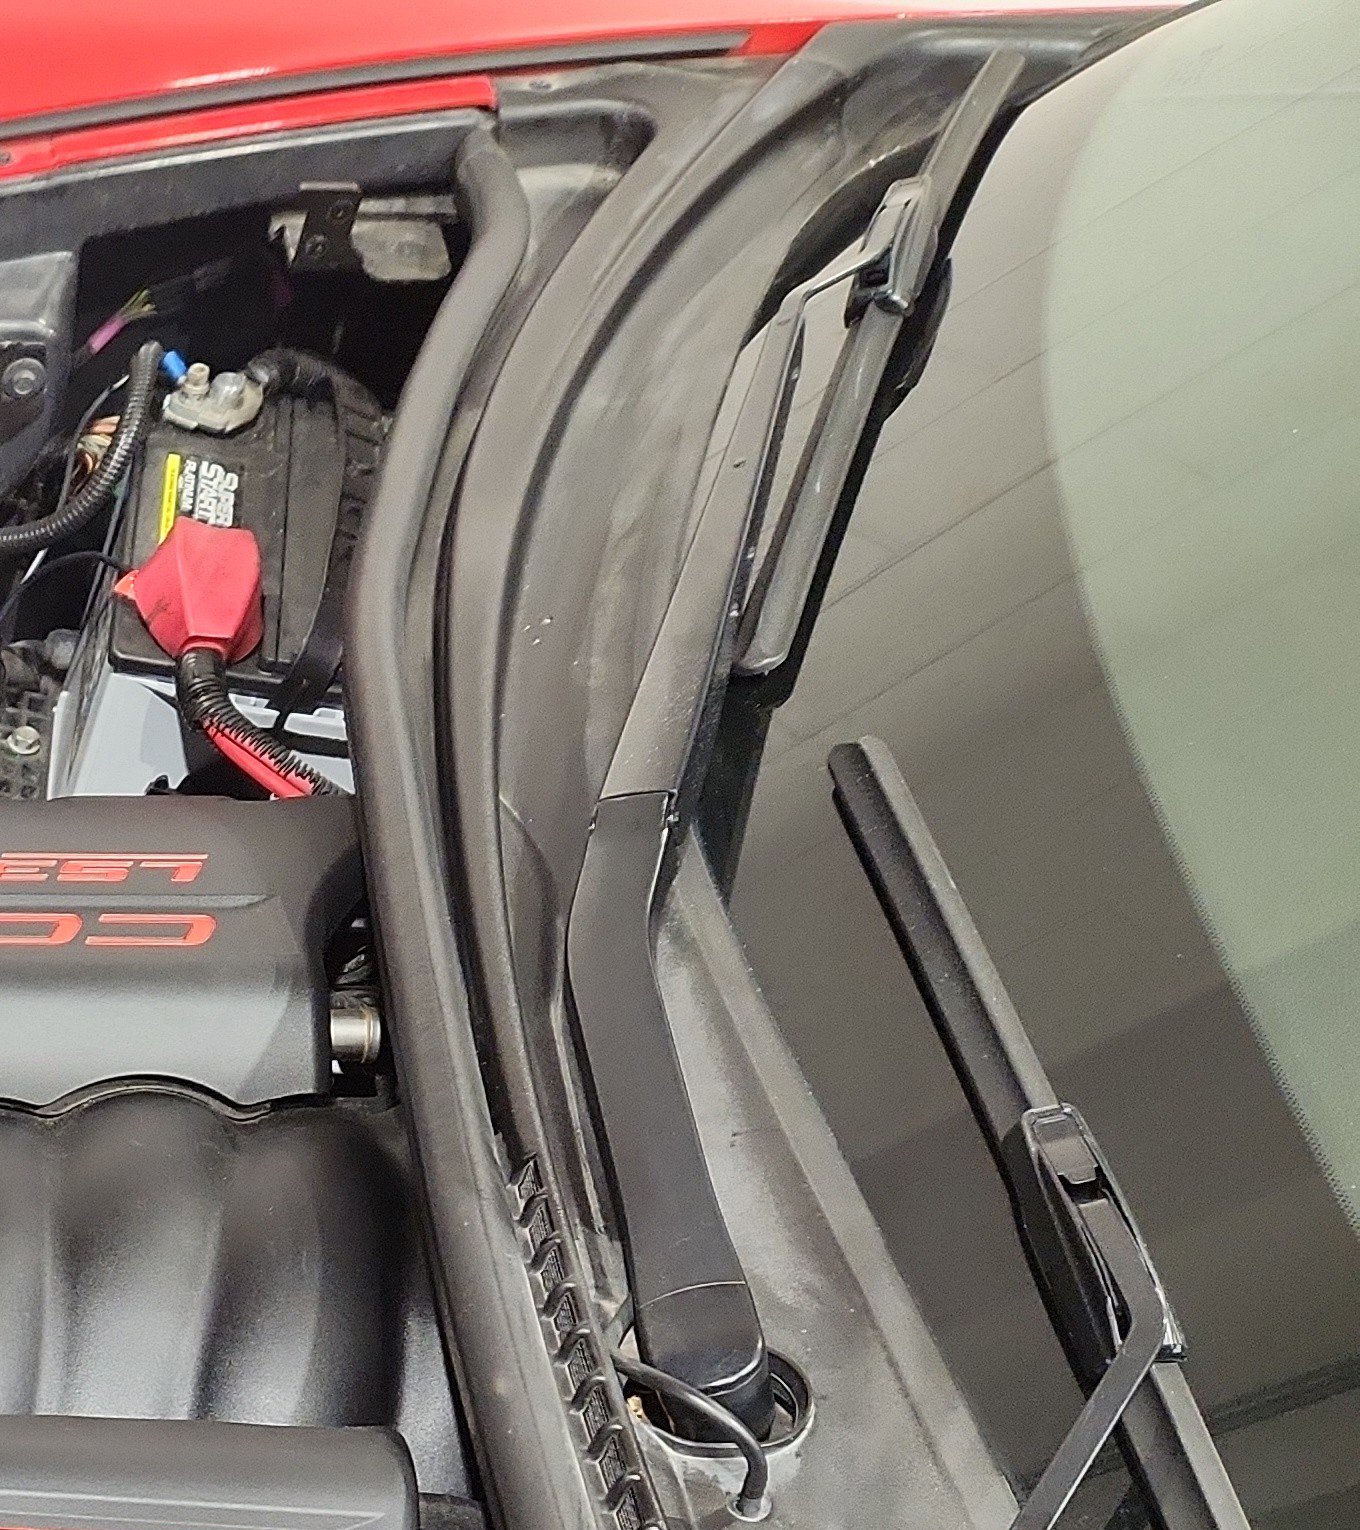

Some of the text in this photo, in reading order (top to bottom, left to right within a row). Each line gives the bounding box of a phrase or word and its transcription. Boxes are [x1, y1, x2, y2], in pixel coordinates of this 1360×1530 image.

[180, 459, 197, 512] PLATINUM
[197, 461, 226, 525] START
[215, 472, 239, 528] SUPER
